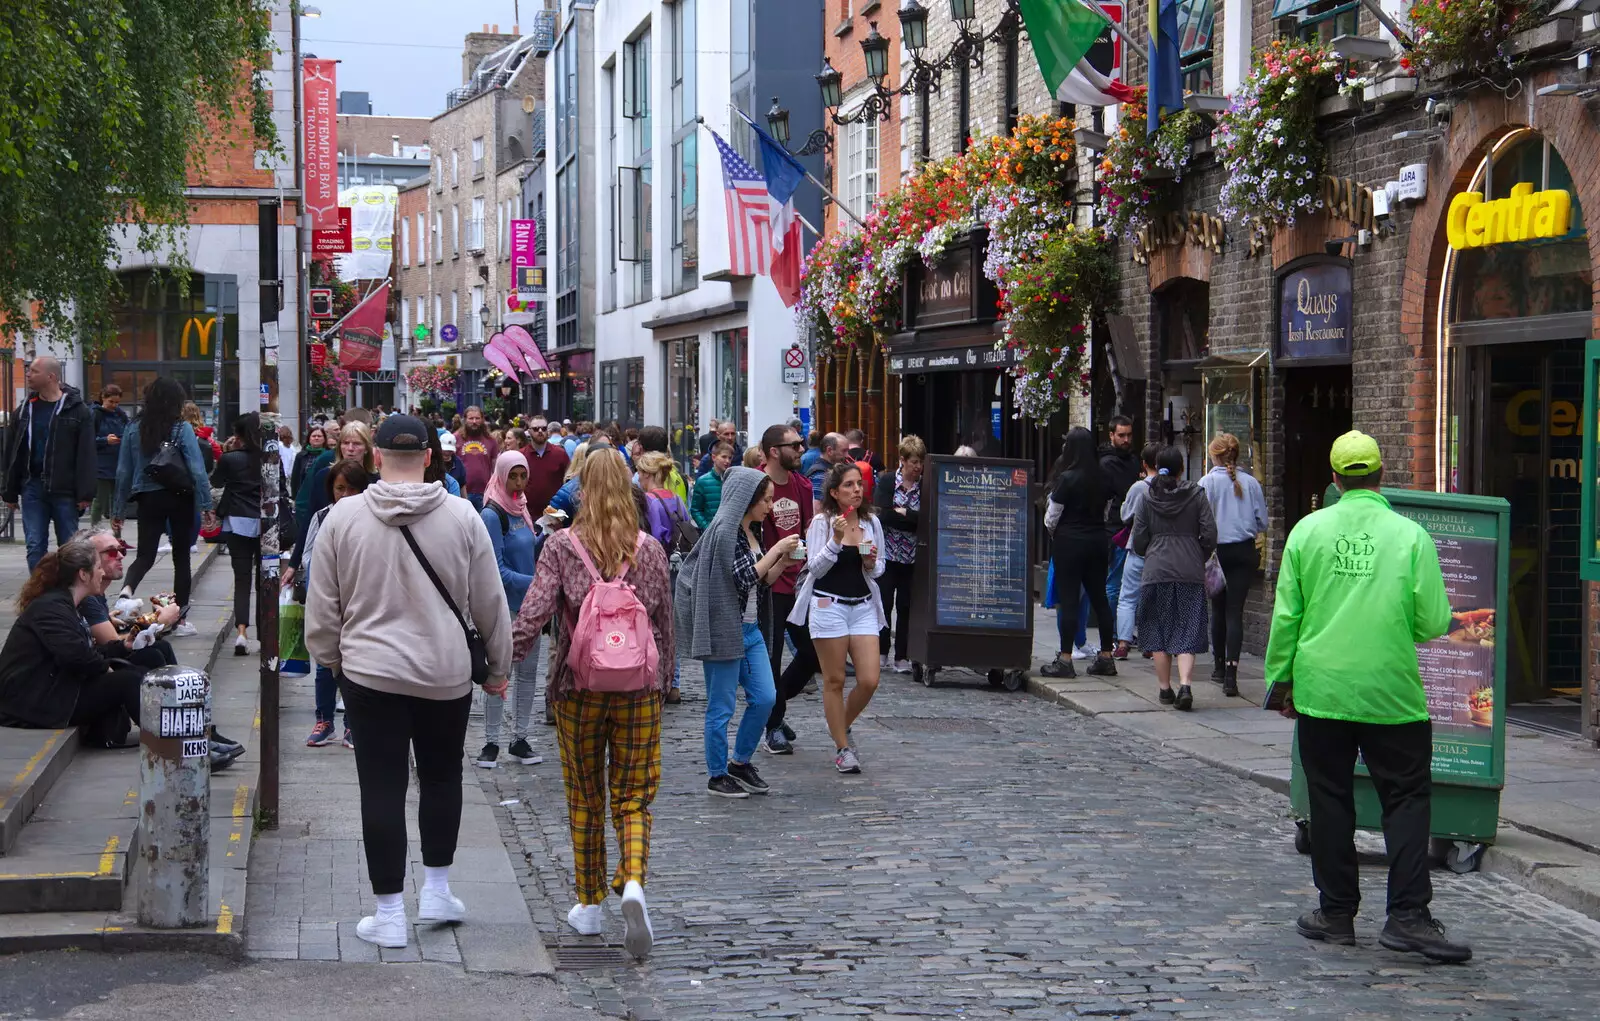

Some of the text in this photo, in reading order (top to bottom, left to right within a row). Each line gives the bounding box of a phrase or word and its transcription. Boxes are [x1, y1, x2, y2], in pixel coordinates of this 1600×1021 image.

[307, 106, 317, 181] TRADING CO.
[317, 88, 331, 199] THE TEMPLE BAR
[1401, 171, 1416, 183] LARA
[1447, 182, 1571, 250] Centra
[515, 223, 531, 252] NINE
[1297, 278, 1338, 323] Quays
[1288, 320, 1345, 341] Irish Restaurant
[1417, 512, 1440, 521] OLD
[1441, 515, 1467, 524] MILL
[1426, 522, 1475, 534] SPECIALS
[1335, 538, 1375, 556] OLD
[1334, 555, 1373, 570] MILL
[161, 707, 204, 737] BIAFRA
[184, 741, 207, 756] KENS
[1432, 743, 1468, 755] ECIALS
